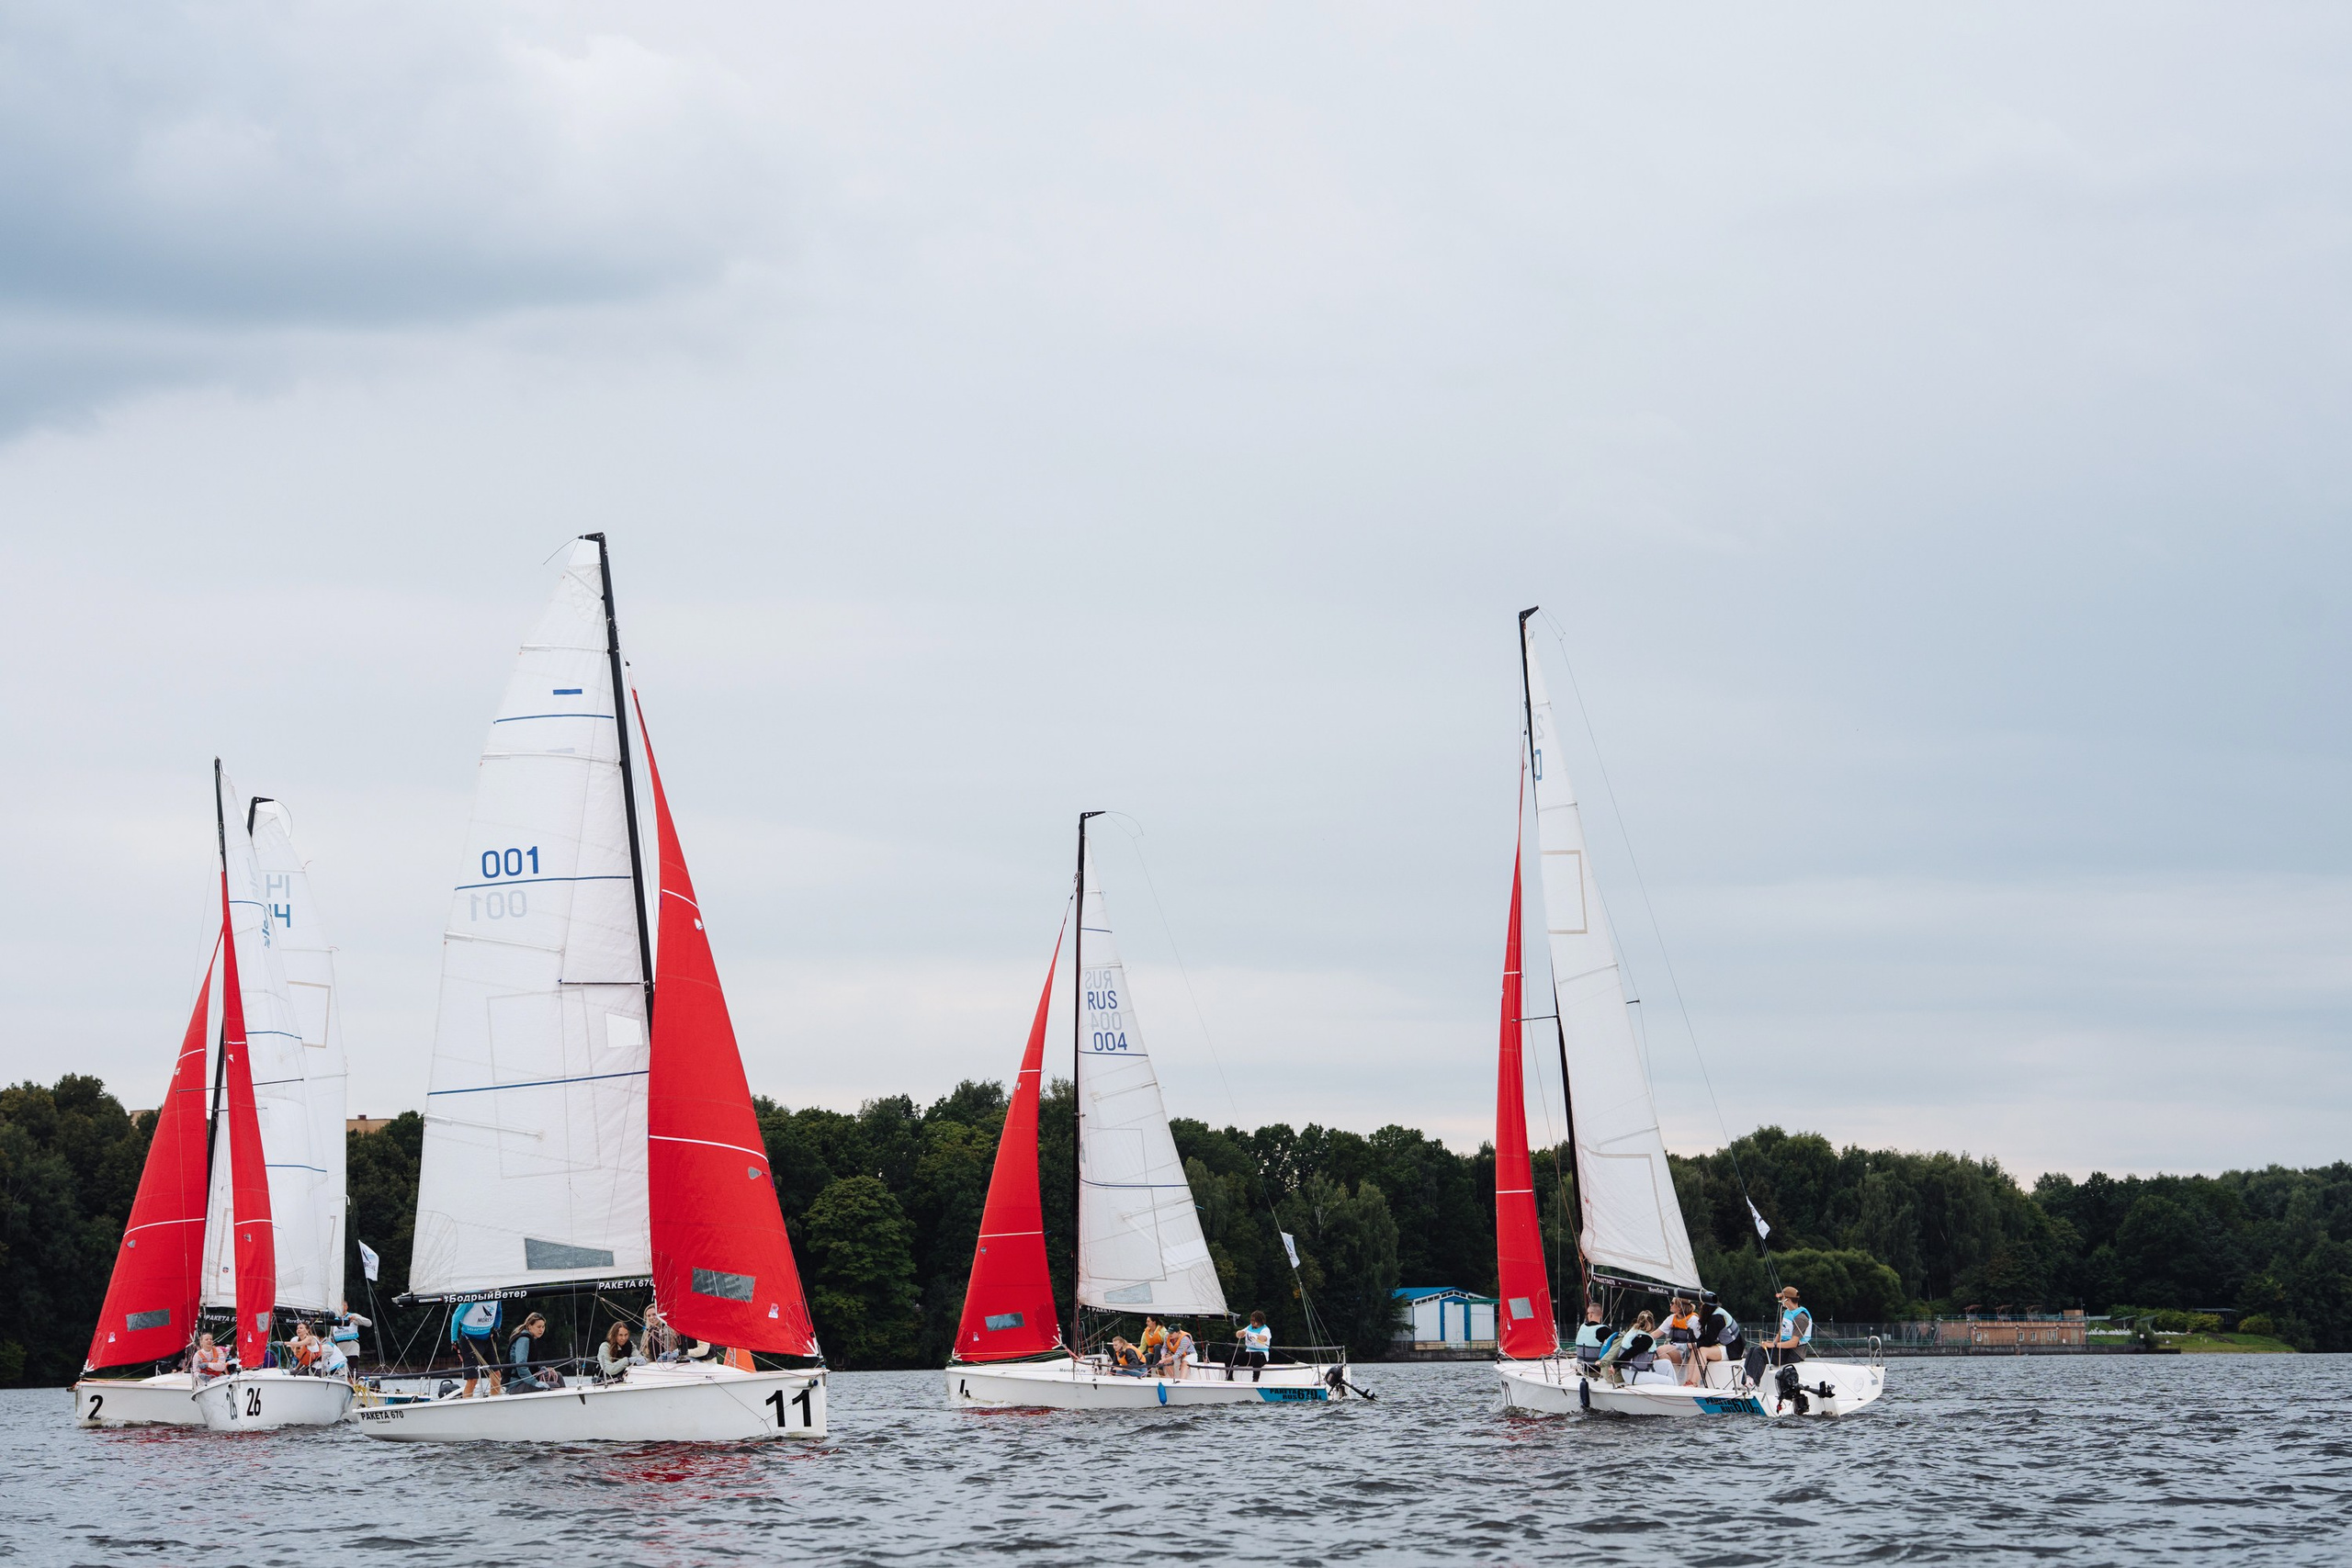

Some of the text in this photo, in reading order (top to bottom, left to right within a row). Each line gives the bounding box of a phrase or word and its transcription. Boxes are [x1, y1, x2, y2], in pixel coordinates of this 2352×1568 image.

[481, 846, 539, 879] 001
[1087, 990, 1118, 1010] RUS
[1093, 1032, 1128, 1052] 004
[598, 1279, 654, 1291] РАКЕТА 670
[246, 1387, 262, 1416] 26
[1297, 1388, 1318, 1401] 670
[87, 1394, 104, 1420] 2
[225, 1391, 239, 1420] 26
[360, 1410, 404, 1421] РАКЕТА 670
[765, 1389, 812, 1427] 11
[1731, 1398, 1756, 1414] 670
